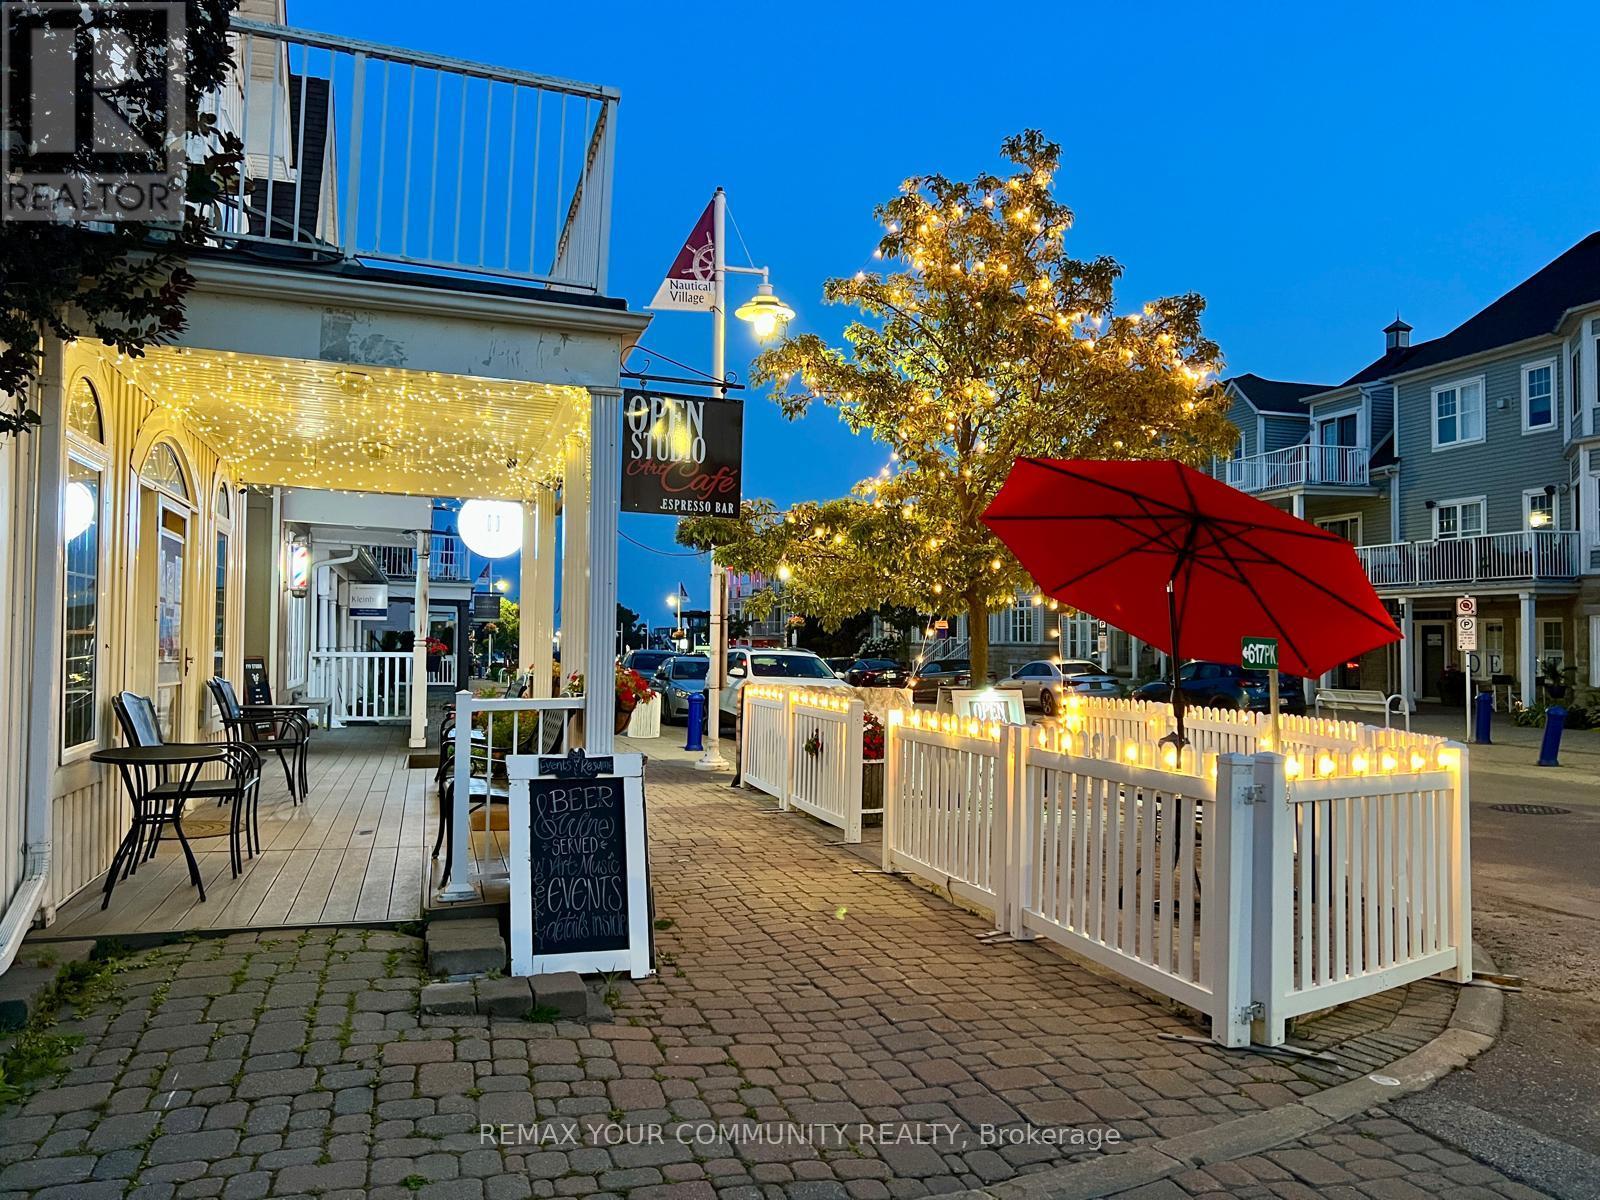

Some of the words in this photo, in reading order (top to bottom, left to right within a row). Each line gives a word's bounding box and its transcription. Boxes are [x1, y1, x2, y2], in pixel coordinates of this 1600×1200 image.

[670, 280, 711, 291] Nautical
[670, 291, 704, 304] Village
[628, 395, 705, 438] OPEN
[631, 431, 706, 464] STUDIO
[660, 462, 738, 500] Café
[661, 499, 712, 513] ESPRESSO
[715, 501, 734, 514] BAR
[973, 702, 1009, 725] OPEN
[550, 785, 614, 814] BEER
[552, 811, 615, 839] Wine
[552, 836, 599, 856] SERVED
[577, 854, 621, 878] Music
[547, 876, 622, 912] EVENTS
[545, 912, 590, 943] details
[592, 911, 627, 937] inside
